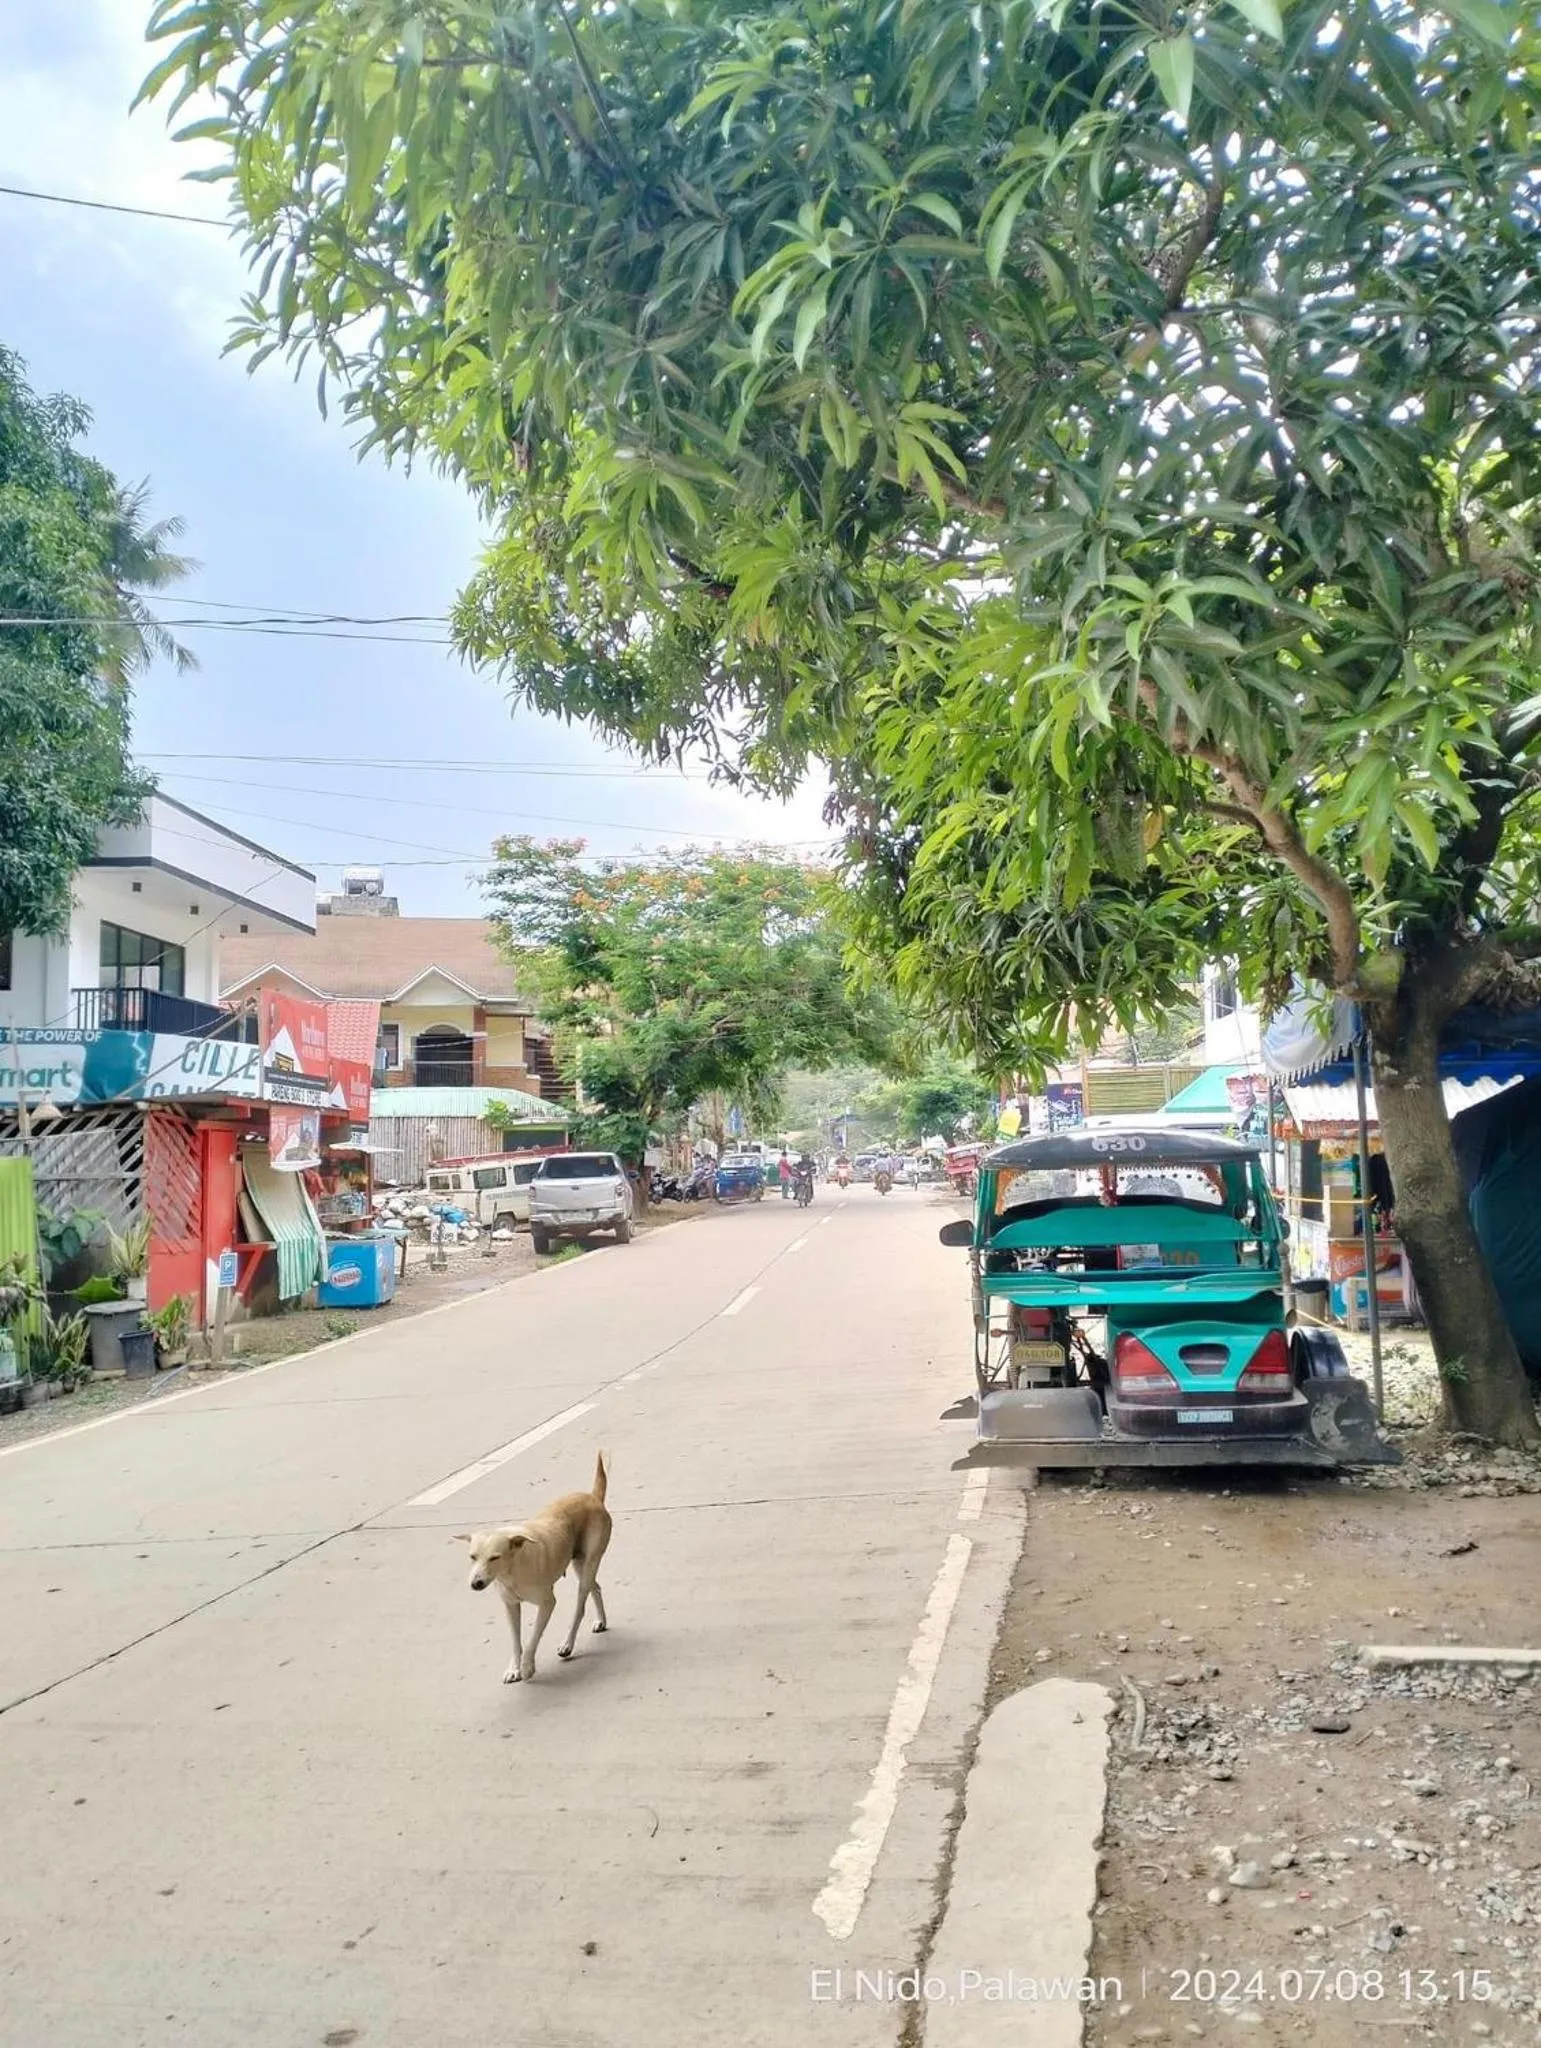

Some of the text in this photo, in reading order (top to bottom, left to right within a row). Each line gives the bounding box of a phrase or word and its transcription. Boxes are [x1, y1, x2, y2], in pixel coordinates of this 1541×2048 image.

[5, 1030, 33, 1041] THE
[35, 1030, 81, 1042] POWER
[84, 1031, 103, 1043] OF
[1092, 1135, 1146, 1151] 630
